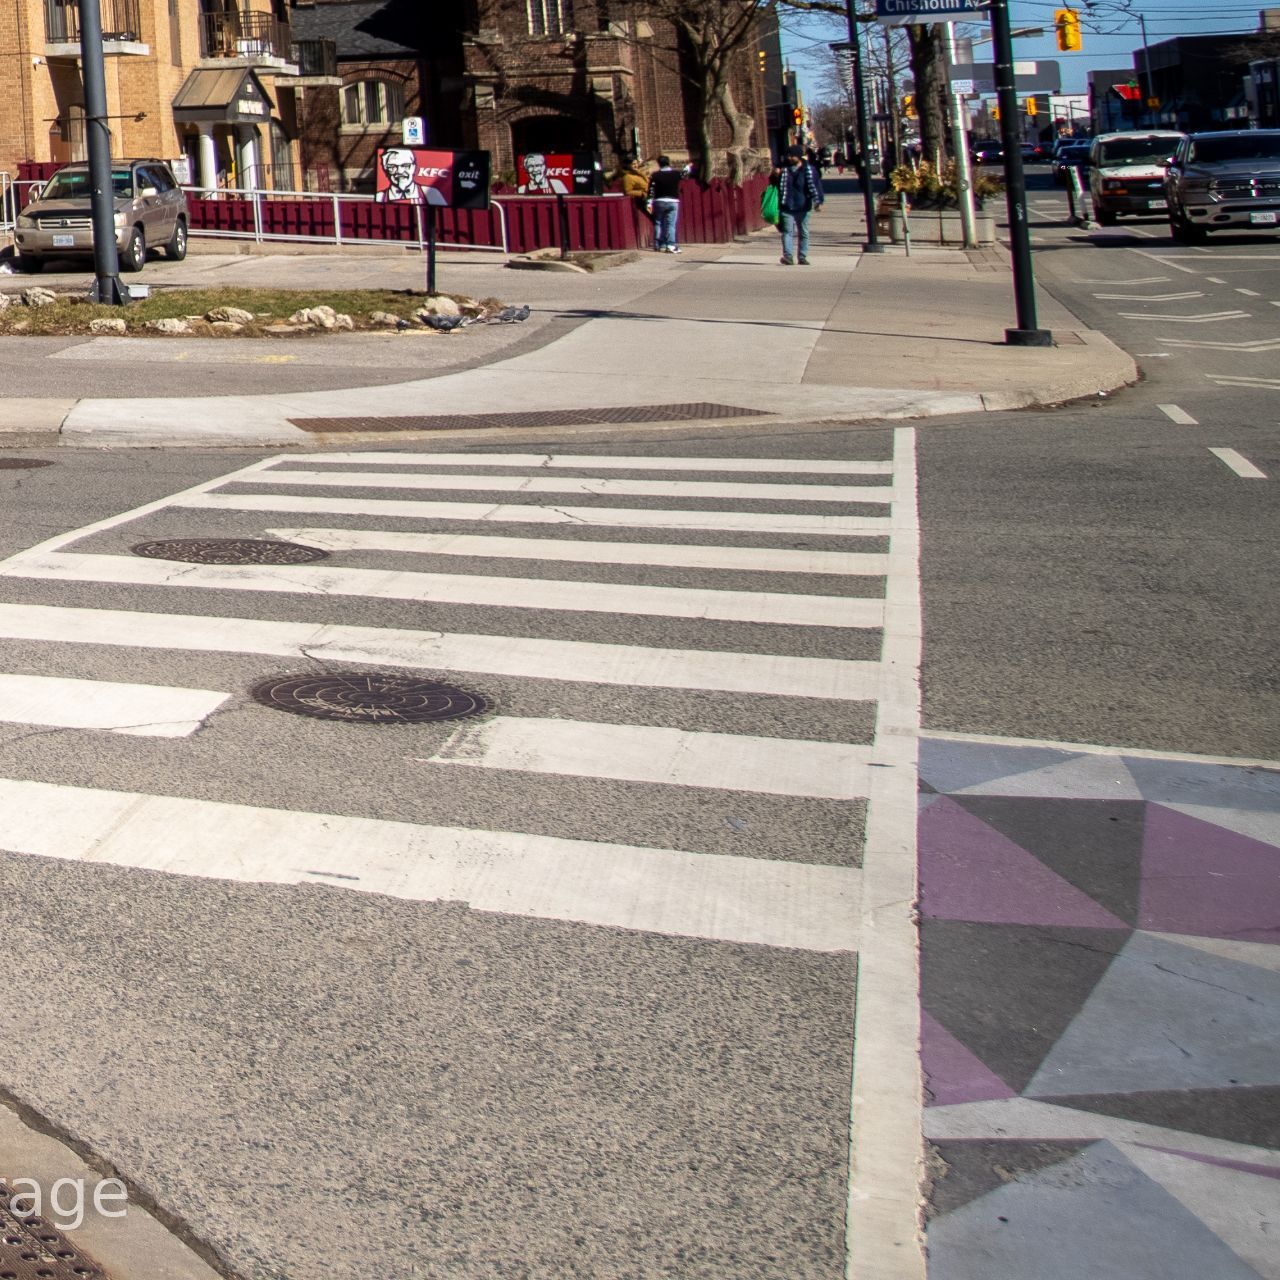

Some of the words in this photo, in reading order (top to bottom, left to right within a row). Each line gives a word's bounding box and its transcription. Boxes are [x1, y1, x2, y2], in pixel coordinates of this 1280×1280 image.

[417, 166, 450, 179] KFC
[458, 169, 480, 180] exit
[546, 167, 570, 177] KFC
